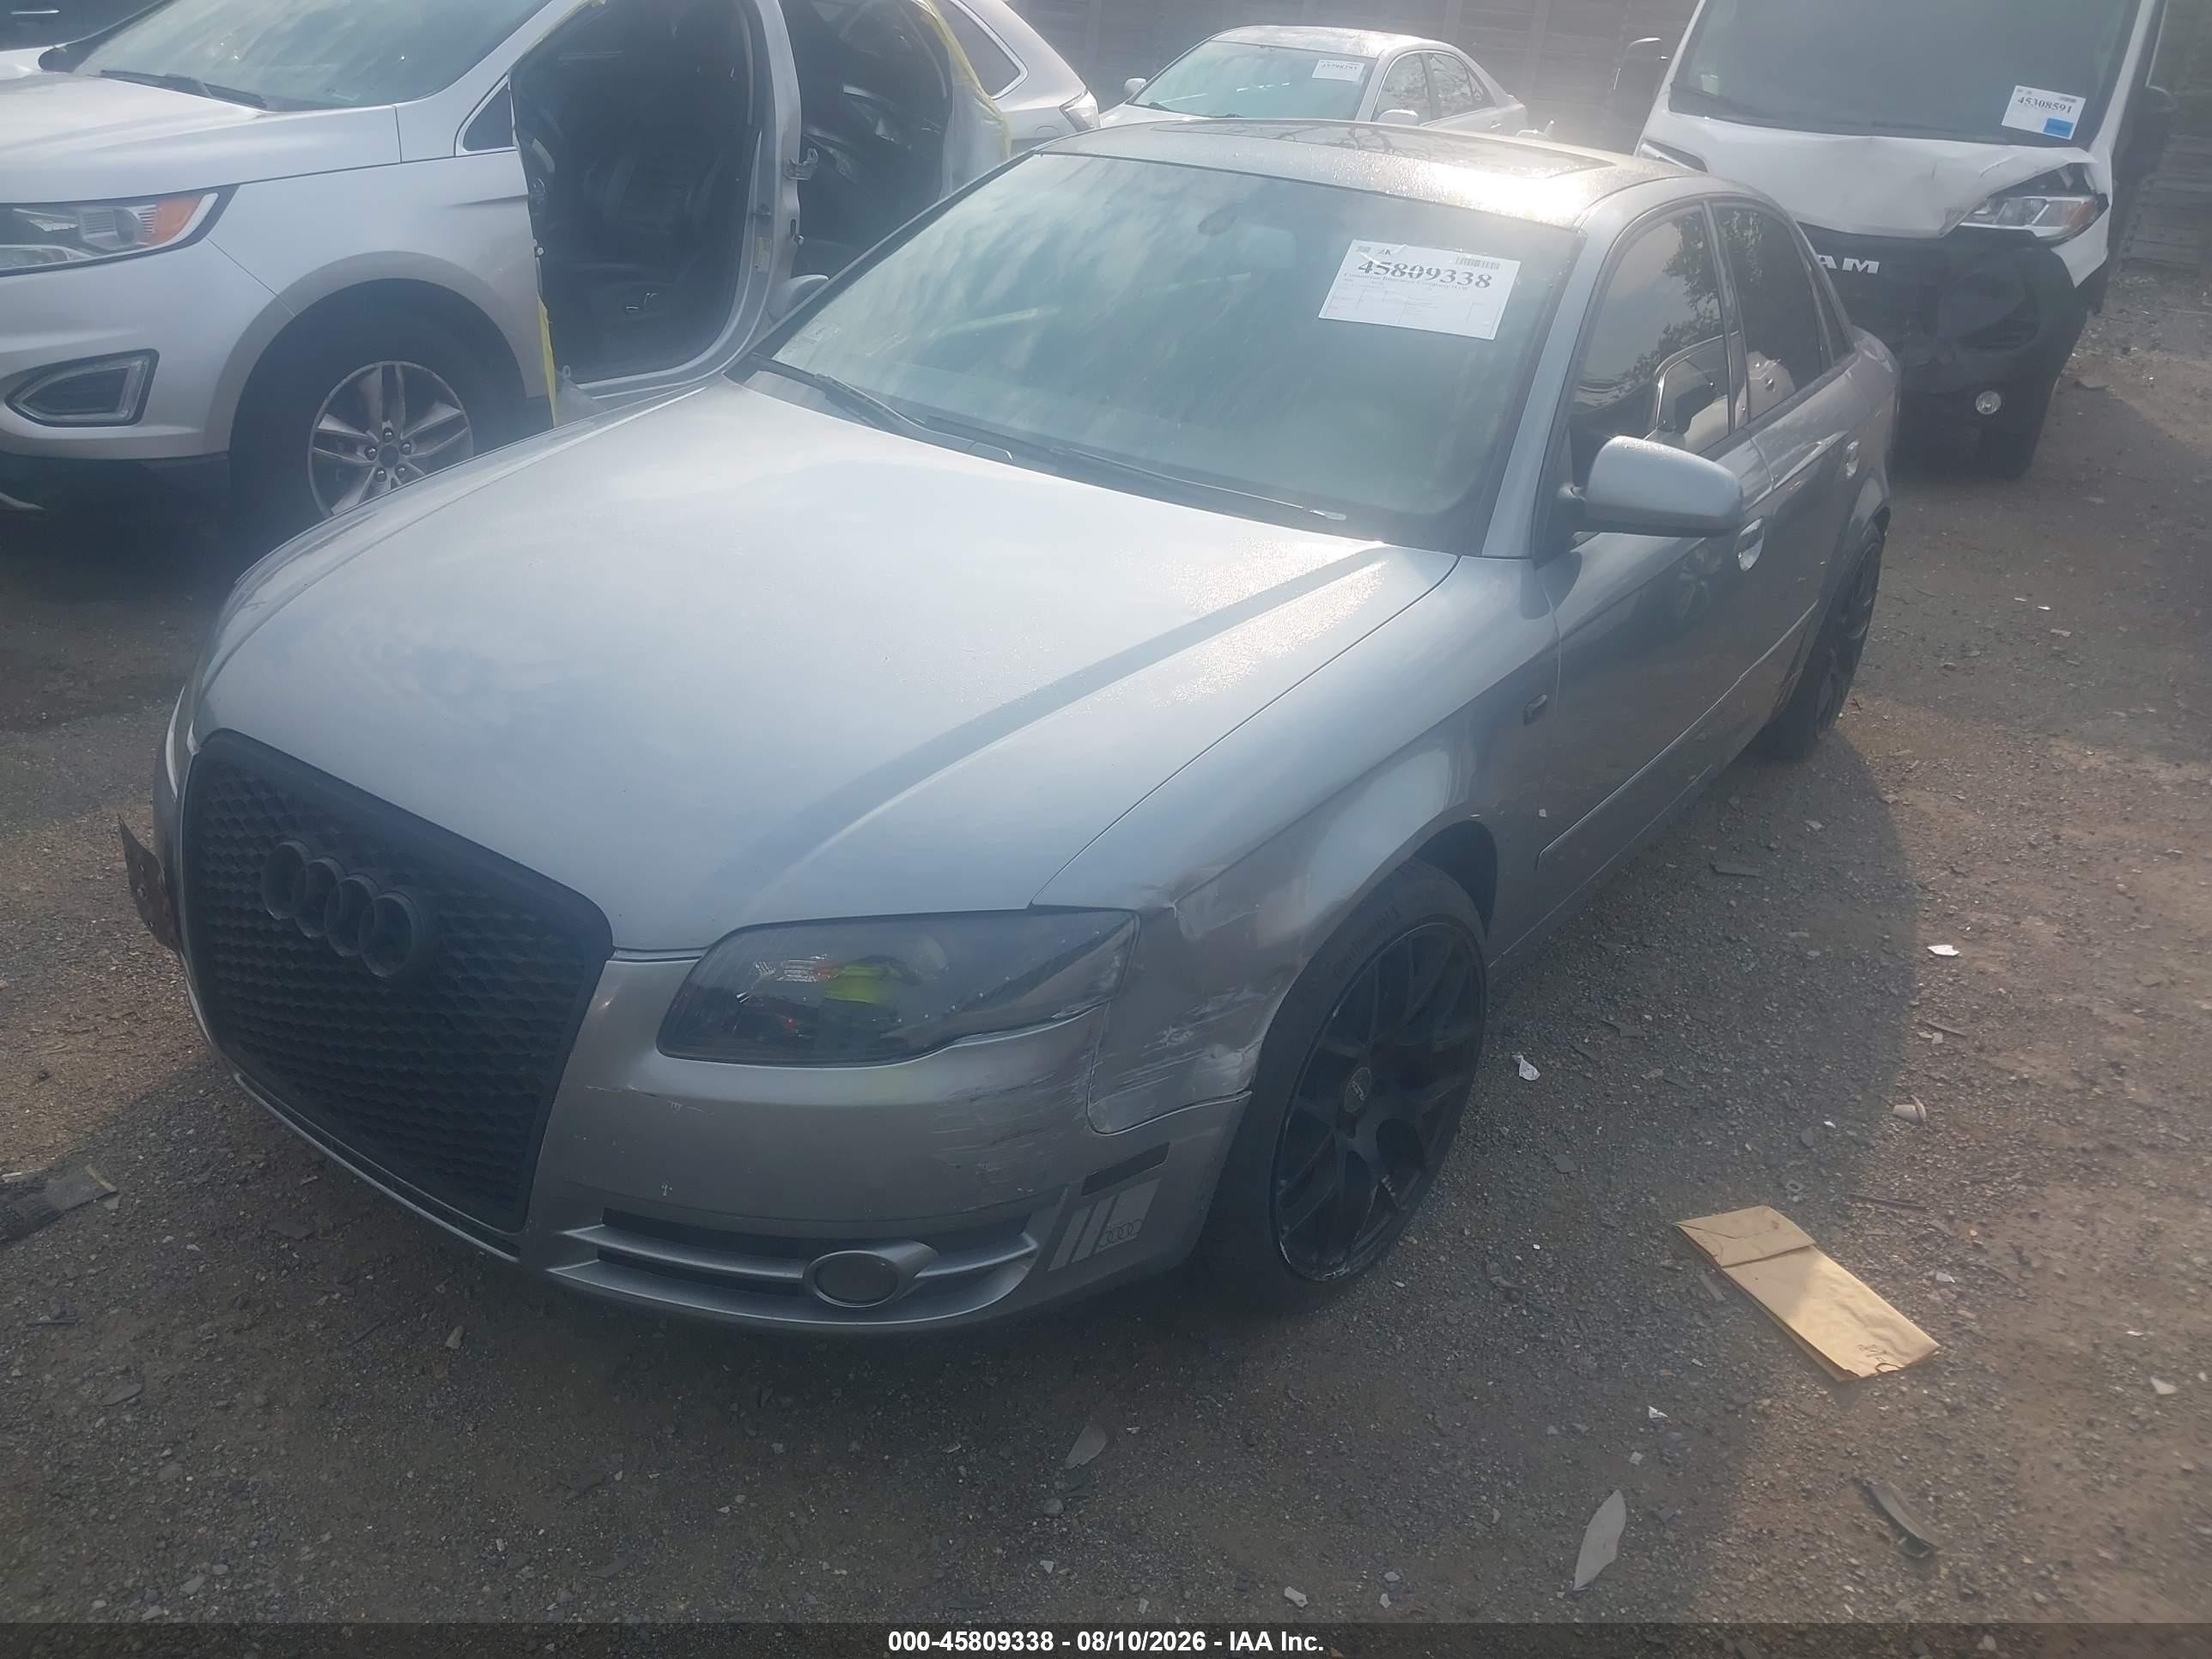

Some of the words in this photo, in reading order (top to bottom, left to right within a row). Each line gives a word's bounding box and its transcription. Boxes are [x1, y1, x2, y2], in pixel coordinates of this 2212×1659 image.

[2017, 96, 2073, 114] 45308591
[1358, 259, 1492, 289] 45809338
[1815, 254, 1880, 274] AM
